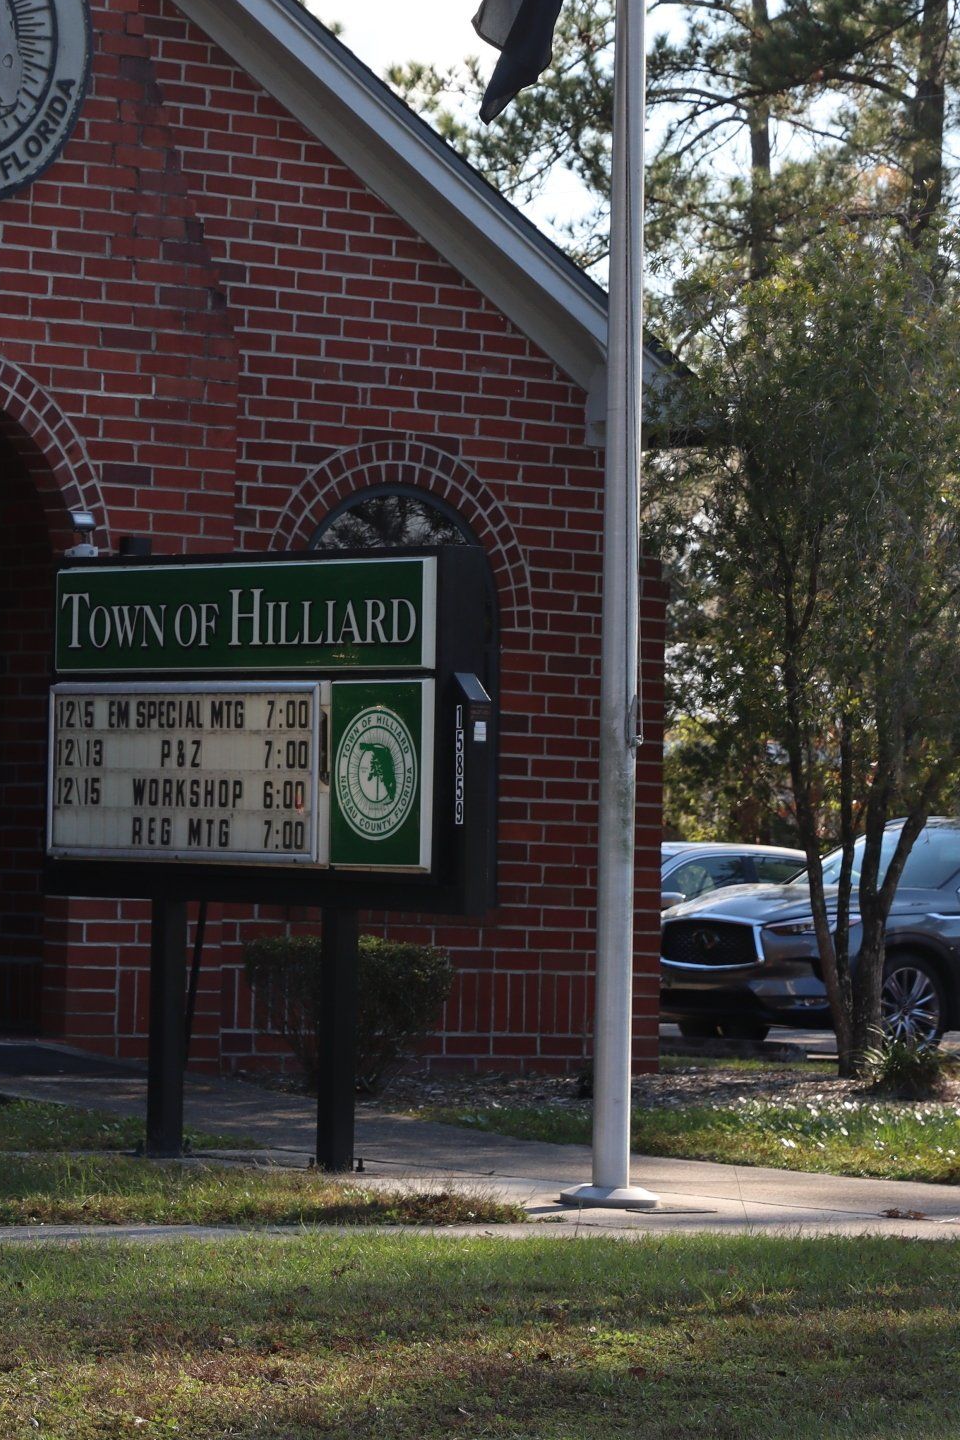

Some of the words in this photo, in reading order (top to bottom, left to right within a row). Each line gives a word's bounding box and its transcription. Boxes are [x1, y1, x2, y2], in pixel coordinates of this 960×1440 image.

[0, 78, 77, 181] FLORIDA
[174, 603, 220, 647] OF
[108, 701, 130, 728] EM
[136, 701, 203, 729] SPECIAL
[211, 700, 244, 729] MTG
[267, 700, 308, 729] 7:00
[265, 740, 308, 769] 7:00
[343, 728, 360, 759] TOWN
[362, 717, 372, 728] OF
[376, 715, 409, 755] HILLIARD
[456, 705, 464, 824] 15859
[133, 778, 243, 808] WORKSHOP
[263, 780, 305, 809] 6:00
[340, 775, 358, 819] NASSAU
[394, 766, 413, 818] FLORIDA
[132, 817, 171, 846] REG
[188, 818, 229, 847] MTG
[264, 820, 305, 850] 7:00
